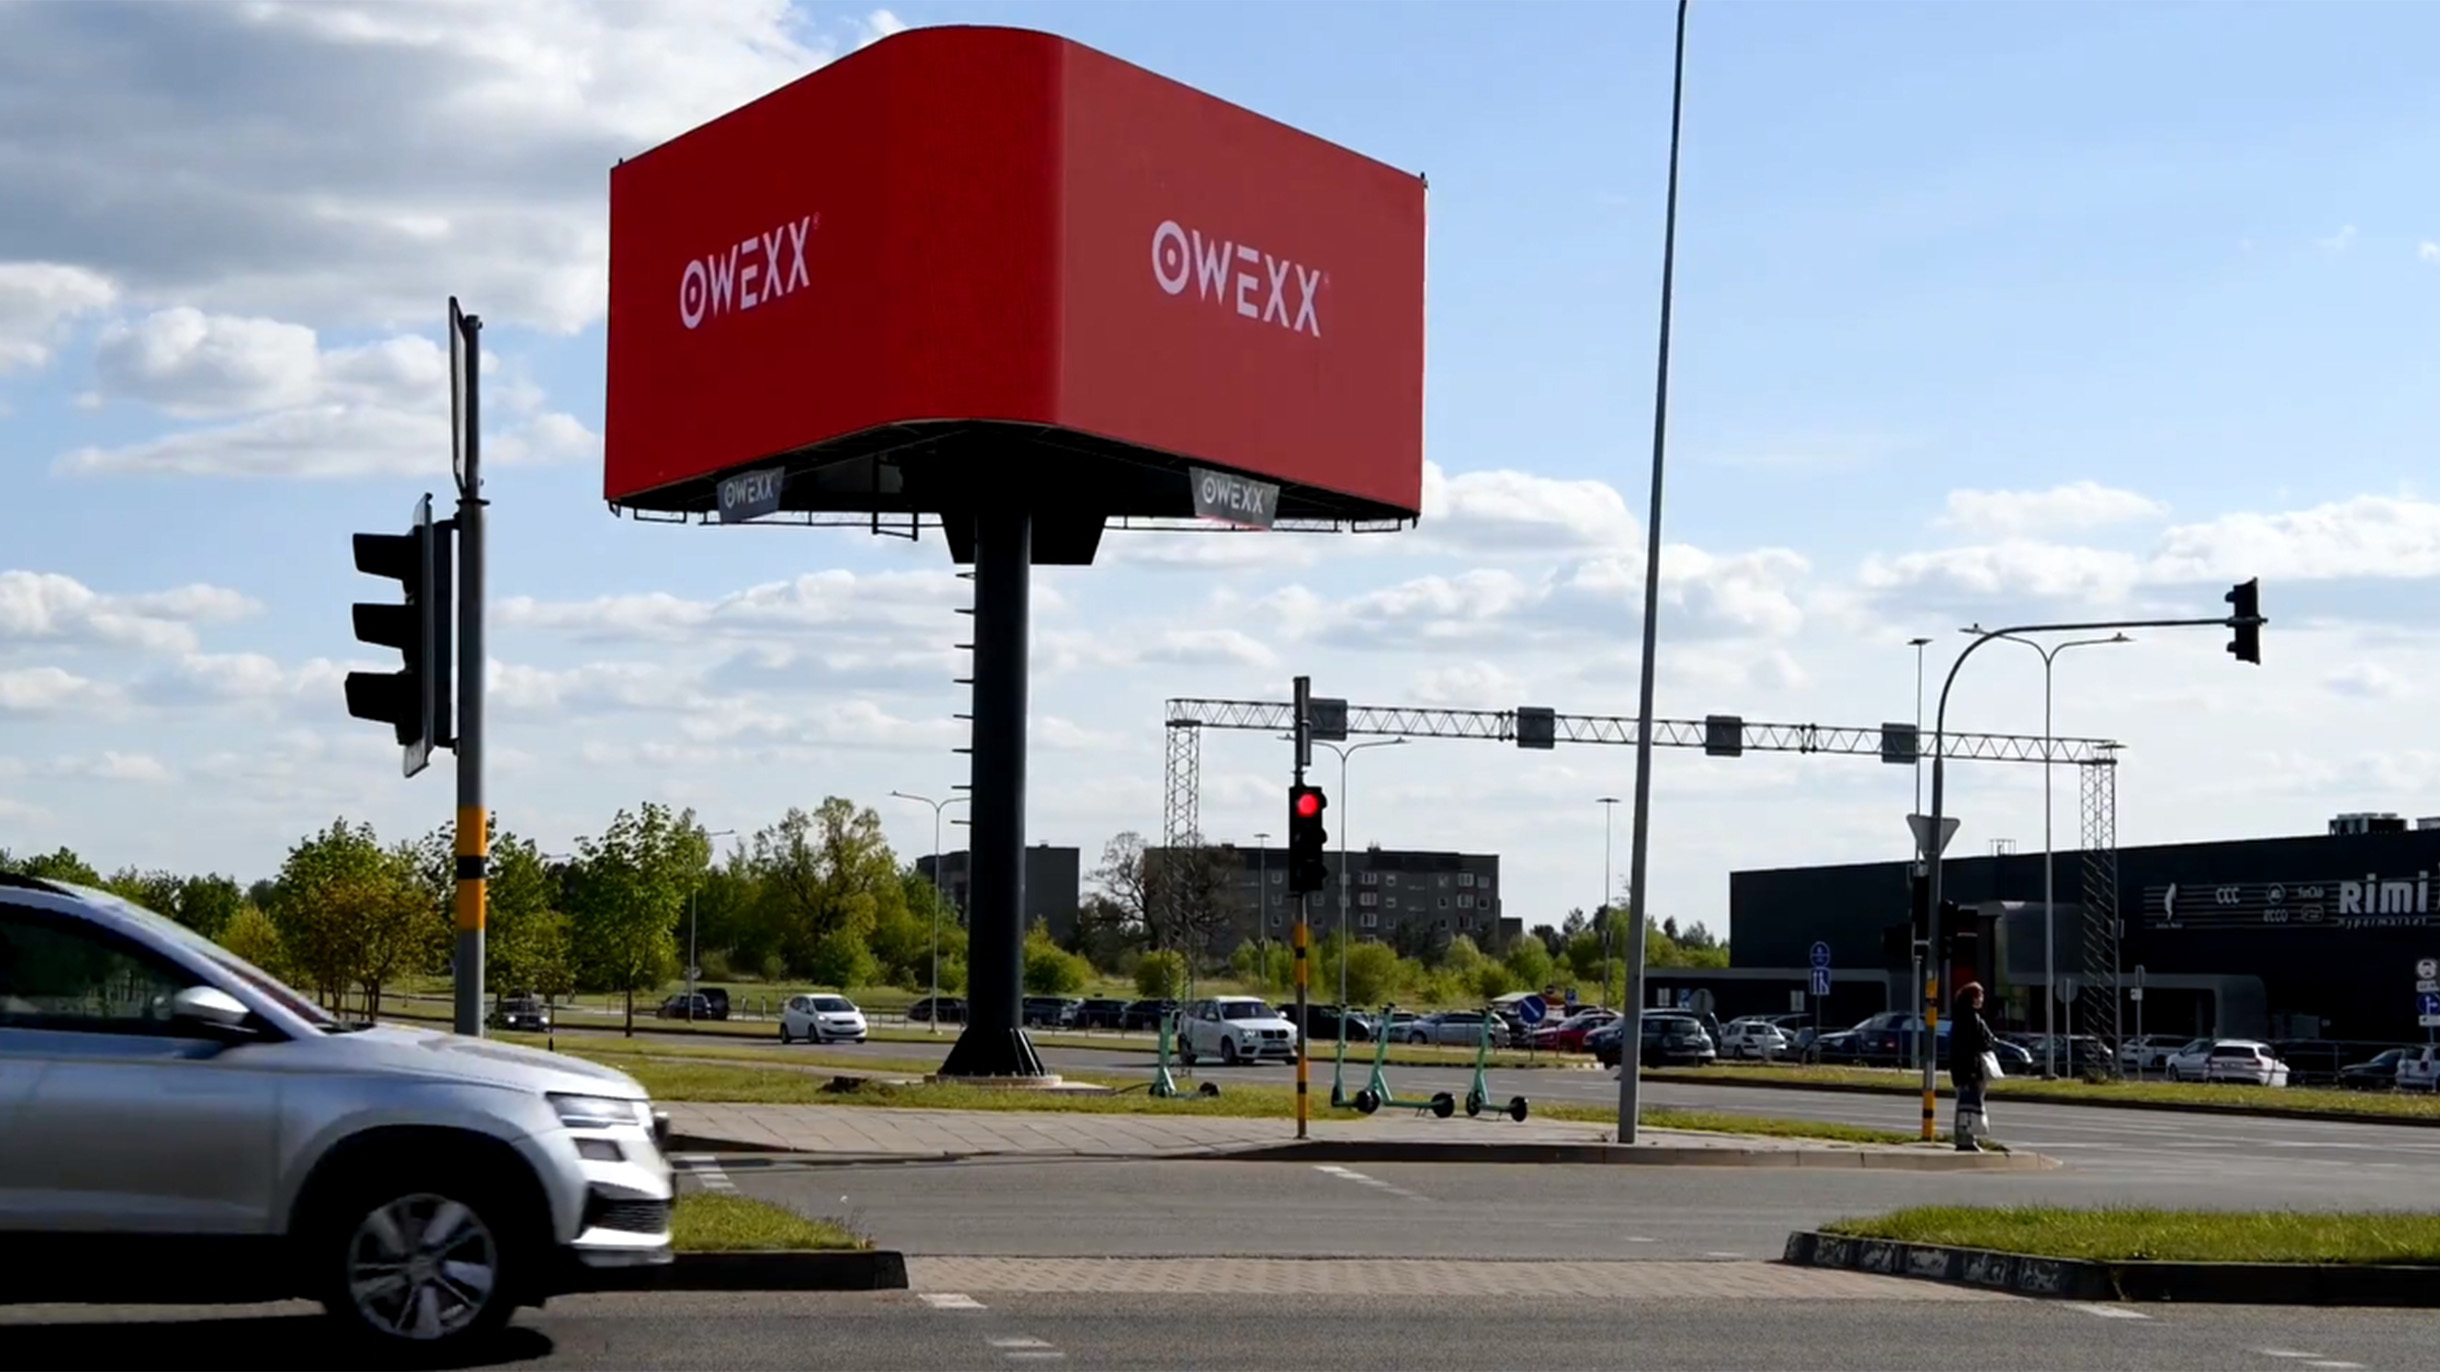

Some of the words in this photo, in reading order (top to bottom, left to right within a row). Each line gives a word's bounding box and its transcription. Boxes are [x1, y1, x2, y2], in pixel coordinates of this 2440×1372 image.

[680, 215, 810, 329] OWEXX
[1151, 220, 1321, 338] OWEXX
[724, 472, 776, 509] OWEXX
[1202, 476, 1264, 514] OWEXX
[2216, 887, 2240, 904] CCC
[2339, 870, 2429, 914] Rimi
